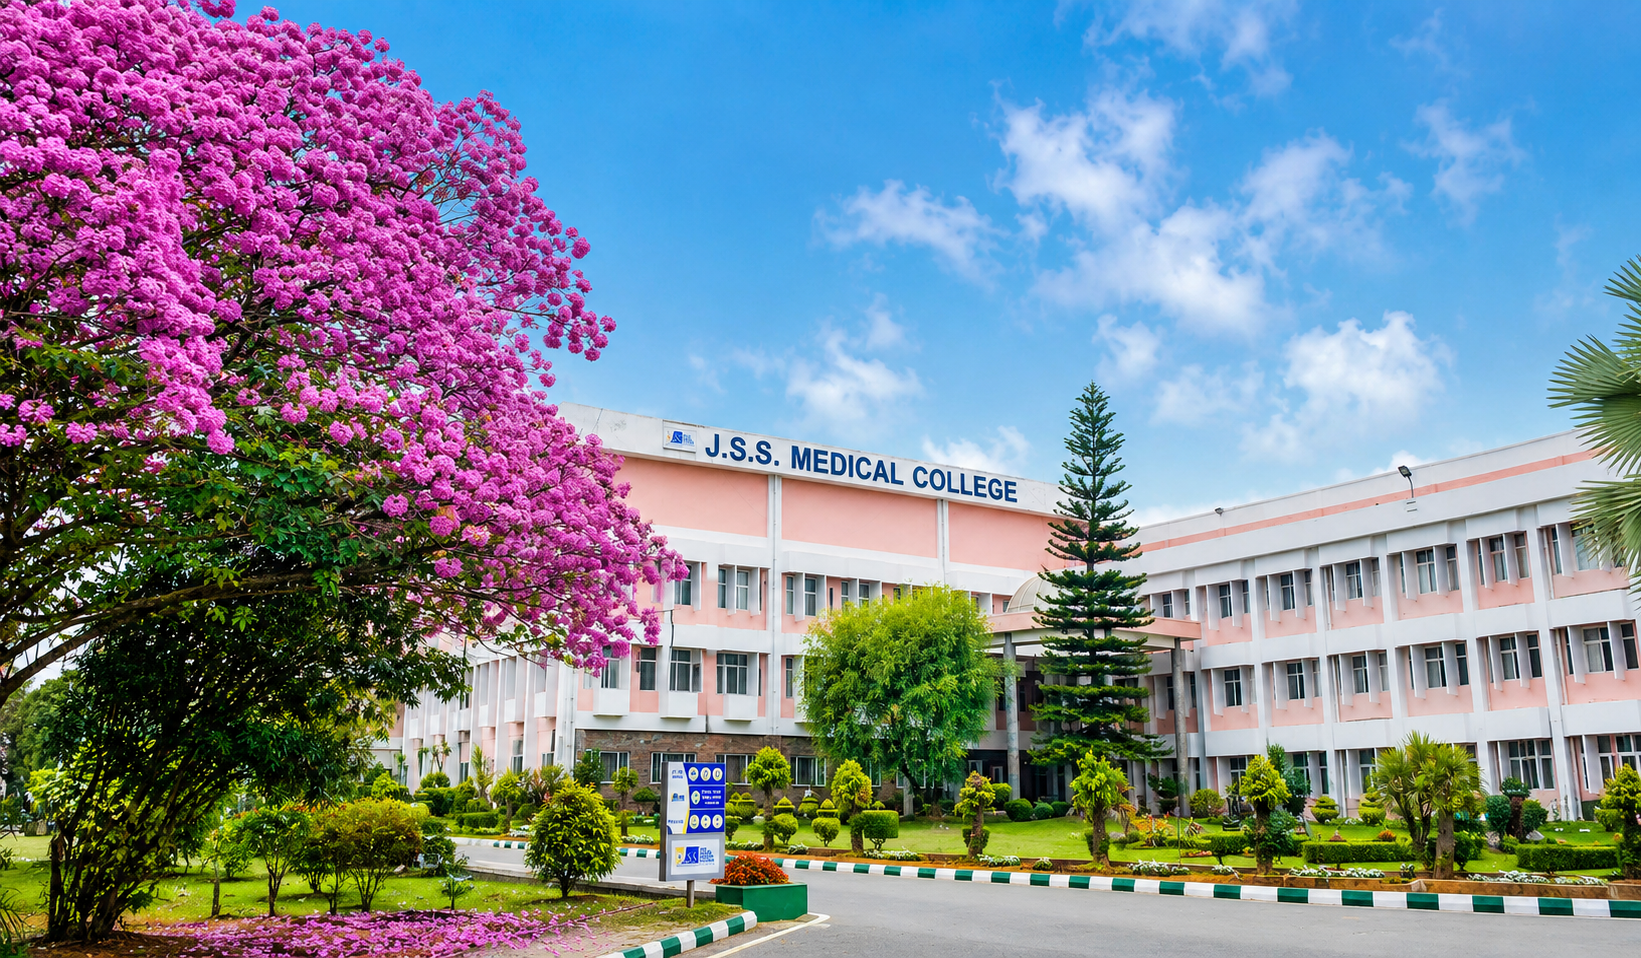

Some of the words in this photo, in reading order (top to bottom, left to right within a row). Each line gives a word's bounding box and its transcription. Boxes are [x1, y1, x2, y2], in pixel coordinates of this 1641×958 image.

[705, 433, 780, 467] J.S.S.
[791, 445, 904, 486] MEDICAL
[912, 465, 1018, 503] COLLEGE
